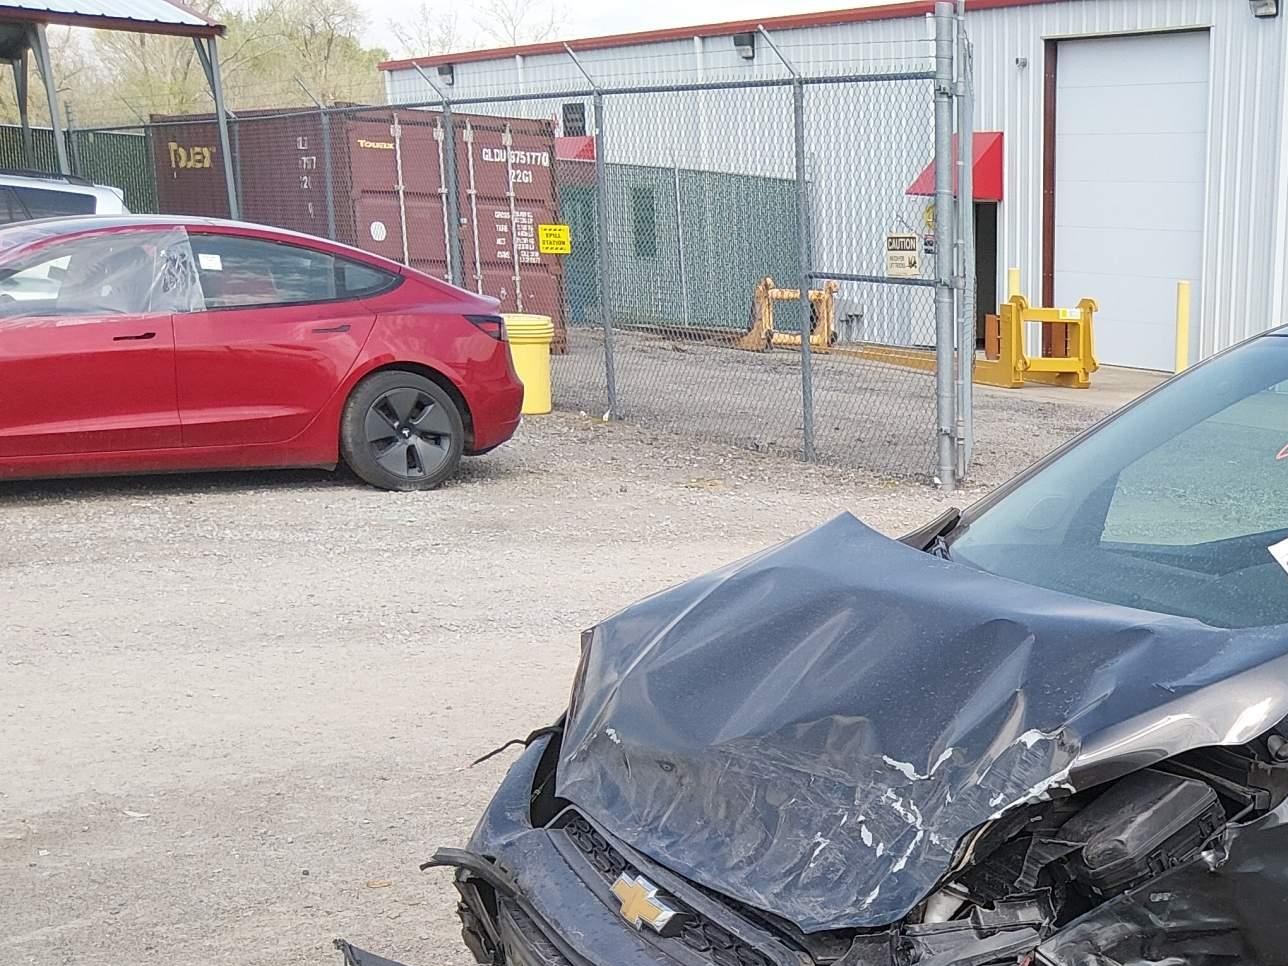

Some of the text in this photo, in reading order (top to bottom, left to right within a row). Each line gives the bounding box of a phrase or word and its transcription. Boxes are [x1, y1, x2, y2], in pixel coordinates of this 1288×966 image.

[482, 148, 506, 162] GLDU
[511, 169, 533, 184] 22G1
[888, 238, 916, 250] CAUTION
